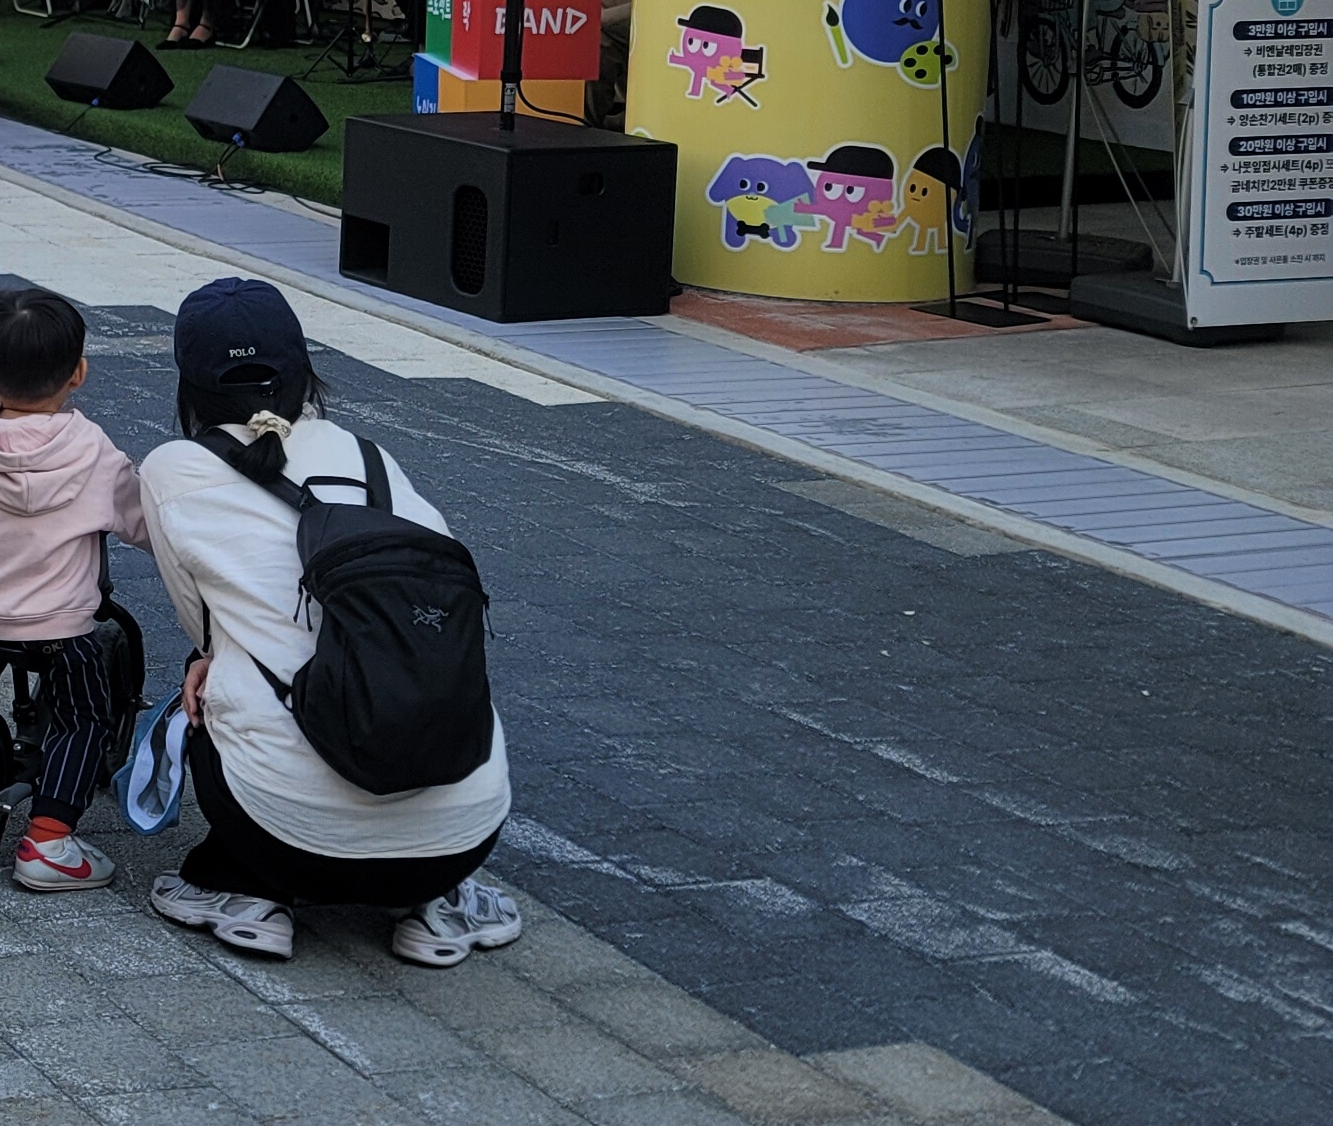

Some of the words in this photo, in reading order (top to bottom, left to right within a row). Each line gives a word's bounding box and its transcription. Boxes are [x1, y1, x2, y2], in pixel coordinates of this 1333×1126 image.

[1248, 23, 1275, 37] 3만원
[1277, 23, 1296, 36] 이상
[1298, 22, 1327, 36] 구입시
[1256, 44, 1323, 58] 비엔날레입장권
[1252, 63, 1307, 78] (통합권2매)
[1241, 92, 1275, 105] 10만원
[1277, 91, 1296, 104] 이상
[1298, 90, 1327, 104] 구입시
[1239, 139, 1274, 152] 20만원
[1276, 138, 1296, 152] 이상
[1298, 137, 1327, 151] 구입시
[1230, 179, 1296, 194] 굽네치킨2만원
[1237, 204, 1273, 218] 30만원
[1275, 203, 1294, 217] 이상
[1296, 202, 1325, 216] 구입시
[1310, 223, 1329, 236] 증정
[229, 346, 256, 358] POLO
